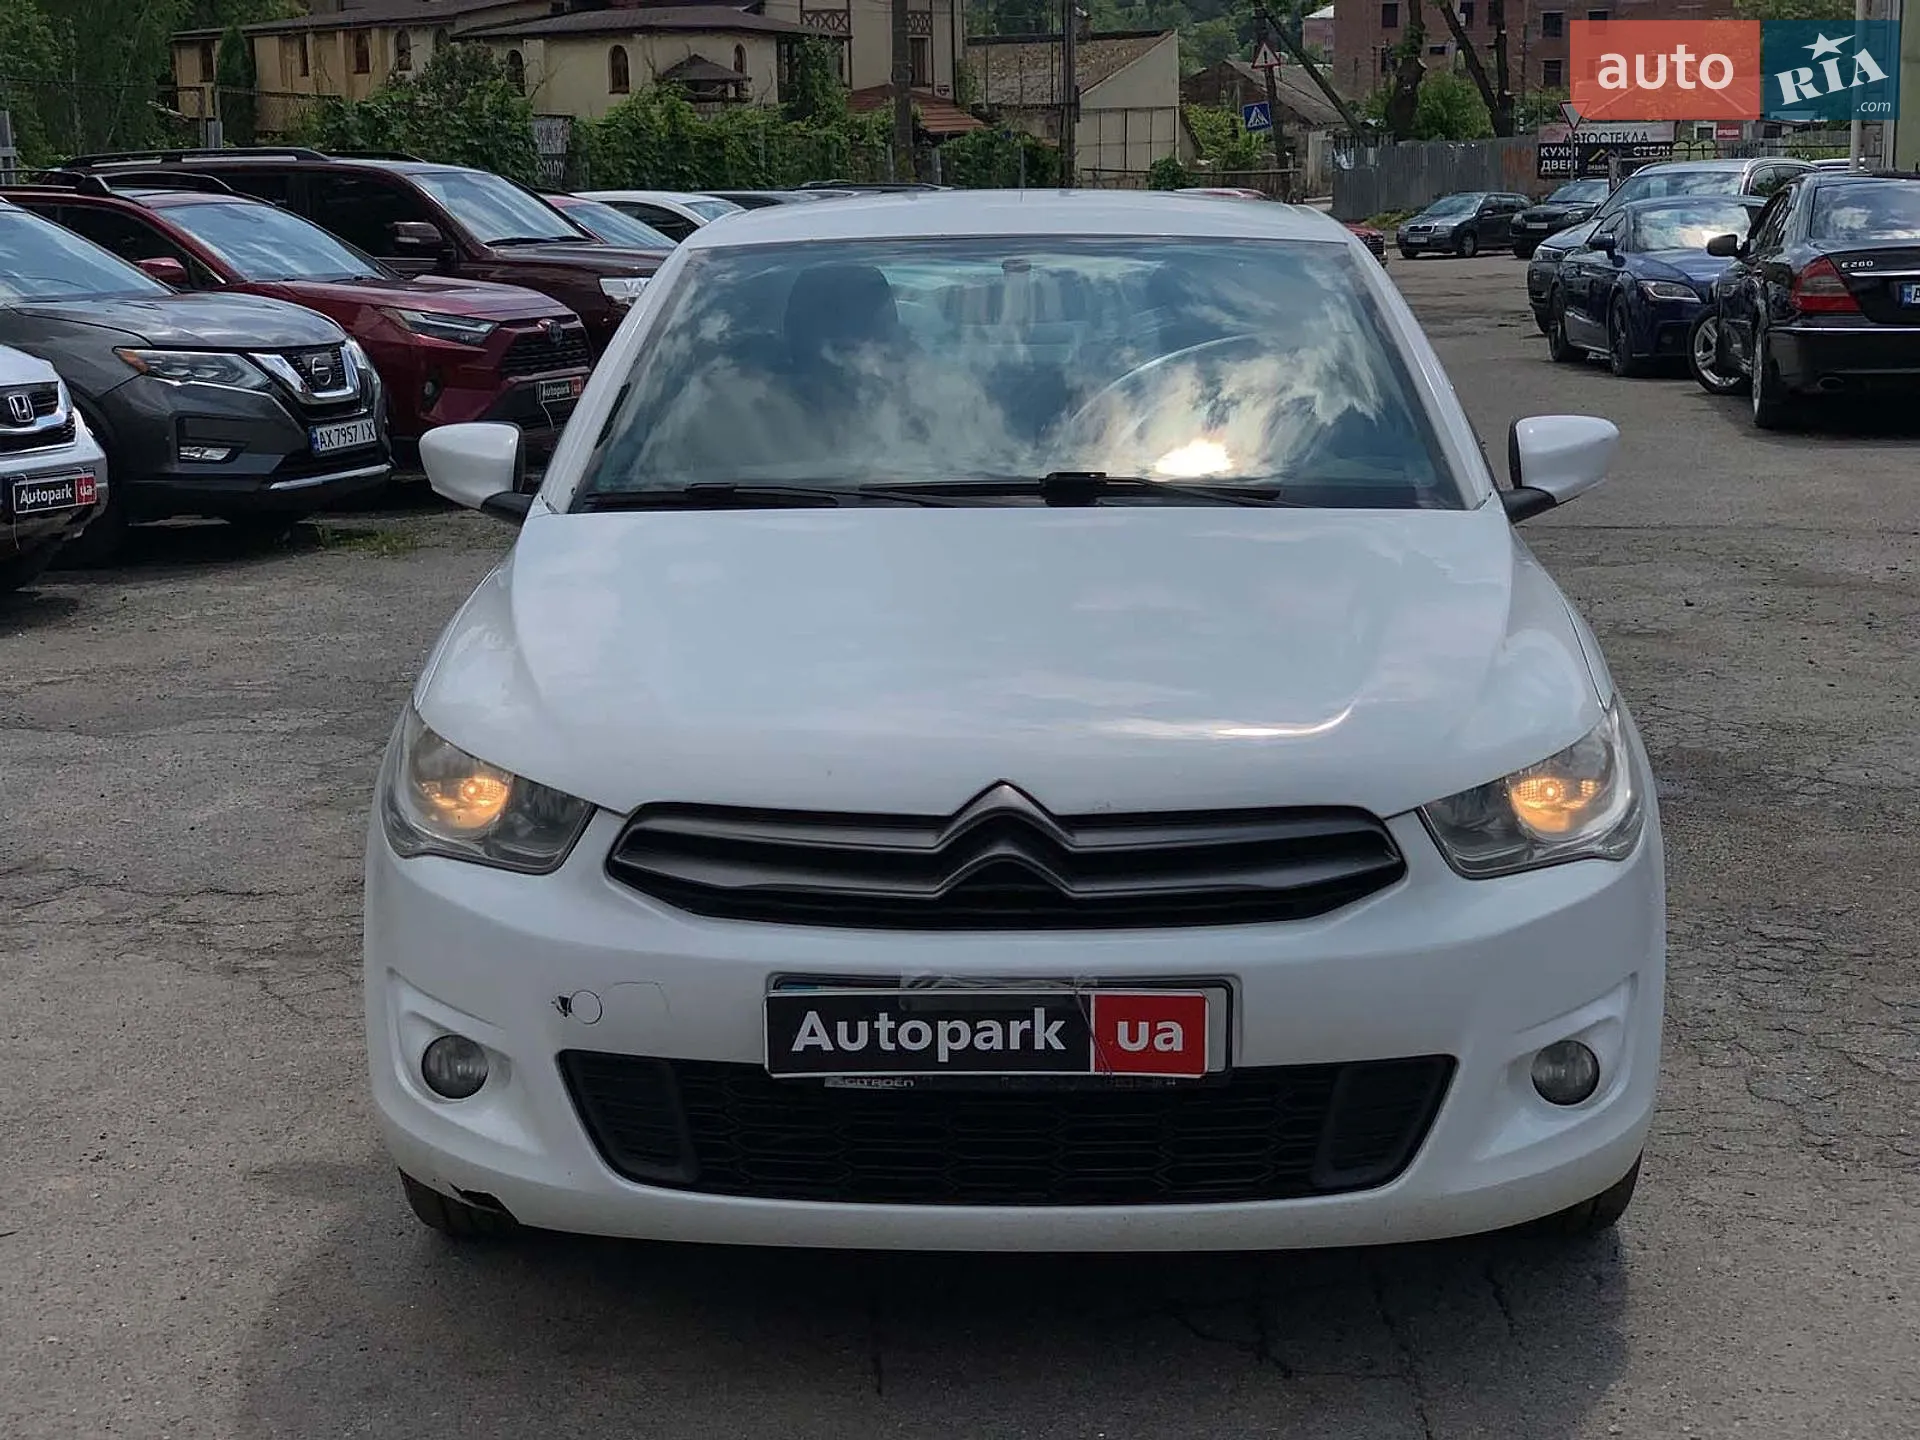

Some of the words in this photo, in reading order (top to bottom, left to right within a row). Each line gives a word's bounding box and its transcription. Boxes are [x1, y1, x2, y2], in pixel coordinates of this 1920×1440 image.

[1564, 131, 1649, 143] АВТОСТЕКЛА
[320, 430, 335, 448] AX
[335, 425, 357, 445] 7957
[361, 423, 375, 440] IX
[20, 484, 72, 505] Autopark
[791, 1007, 1067, 1063] Autopark
[1117, 1020, 1184, 1052] ua
